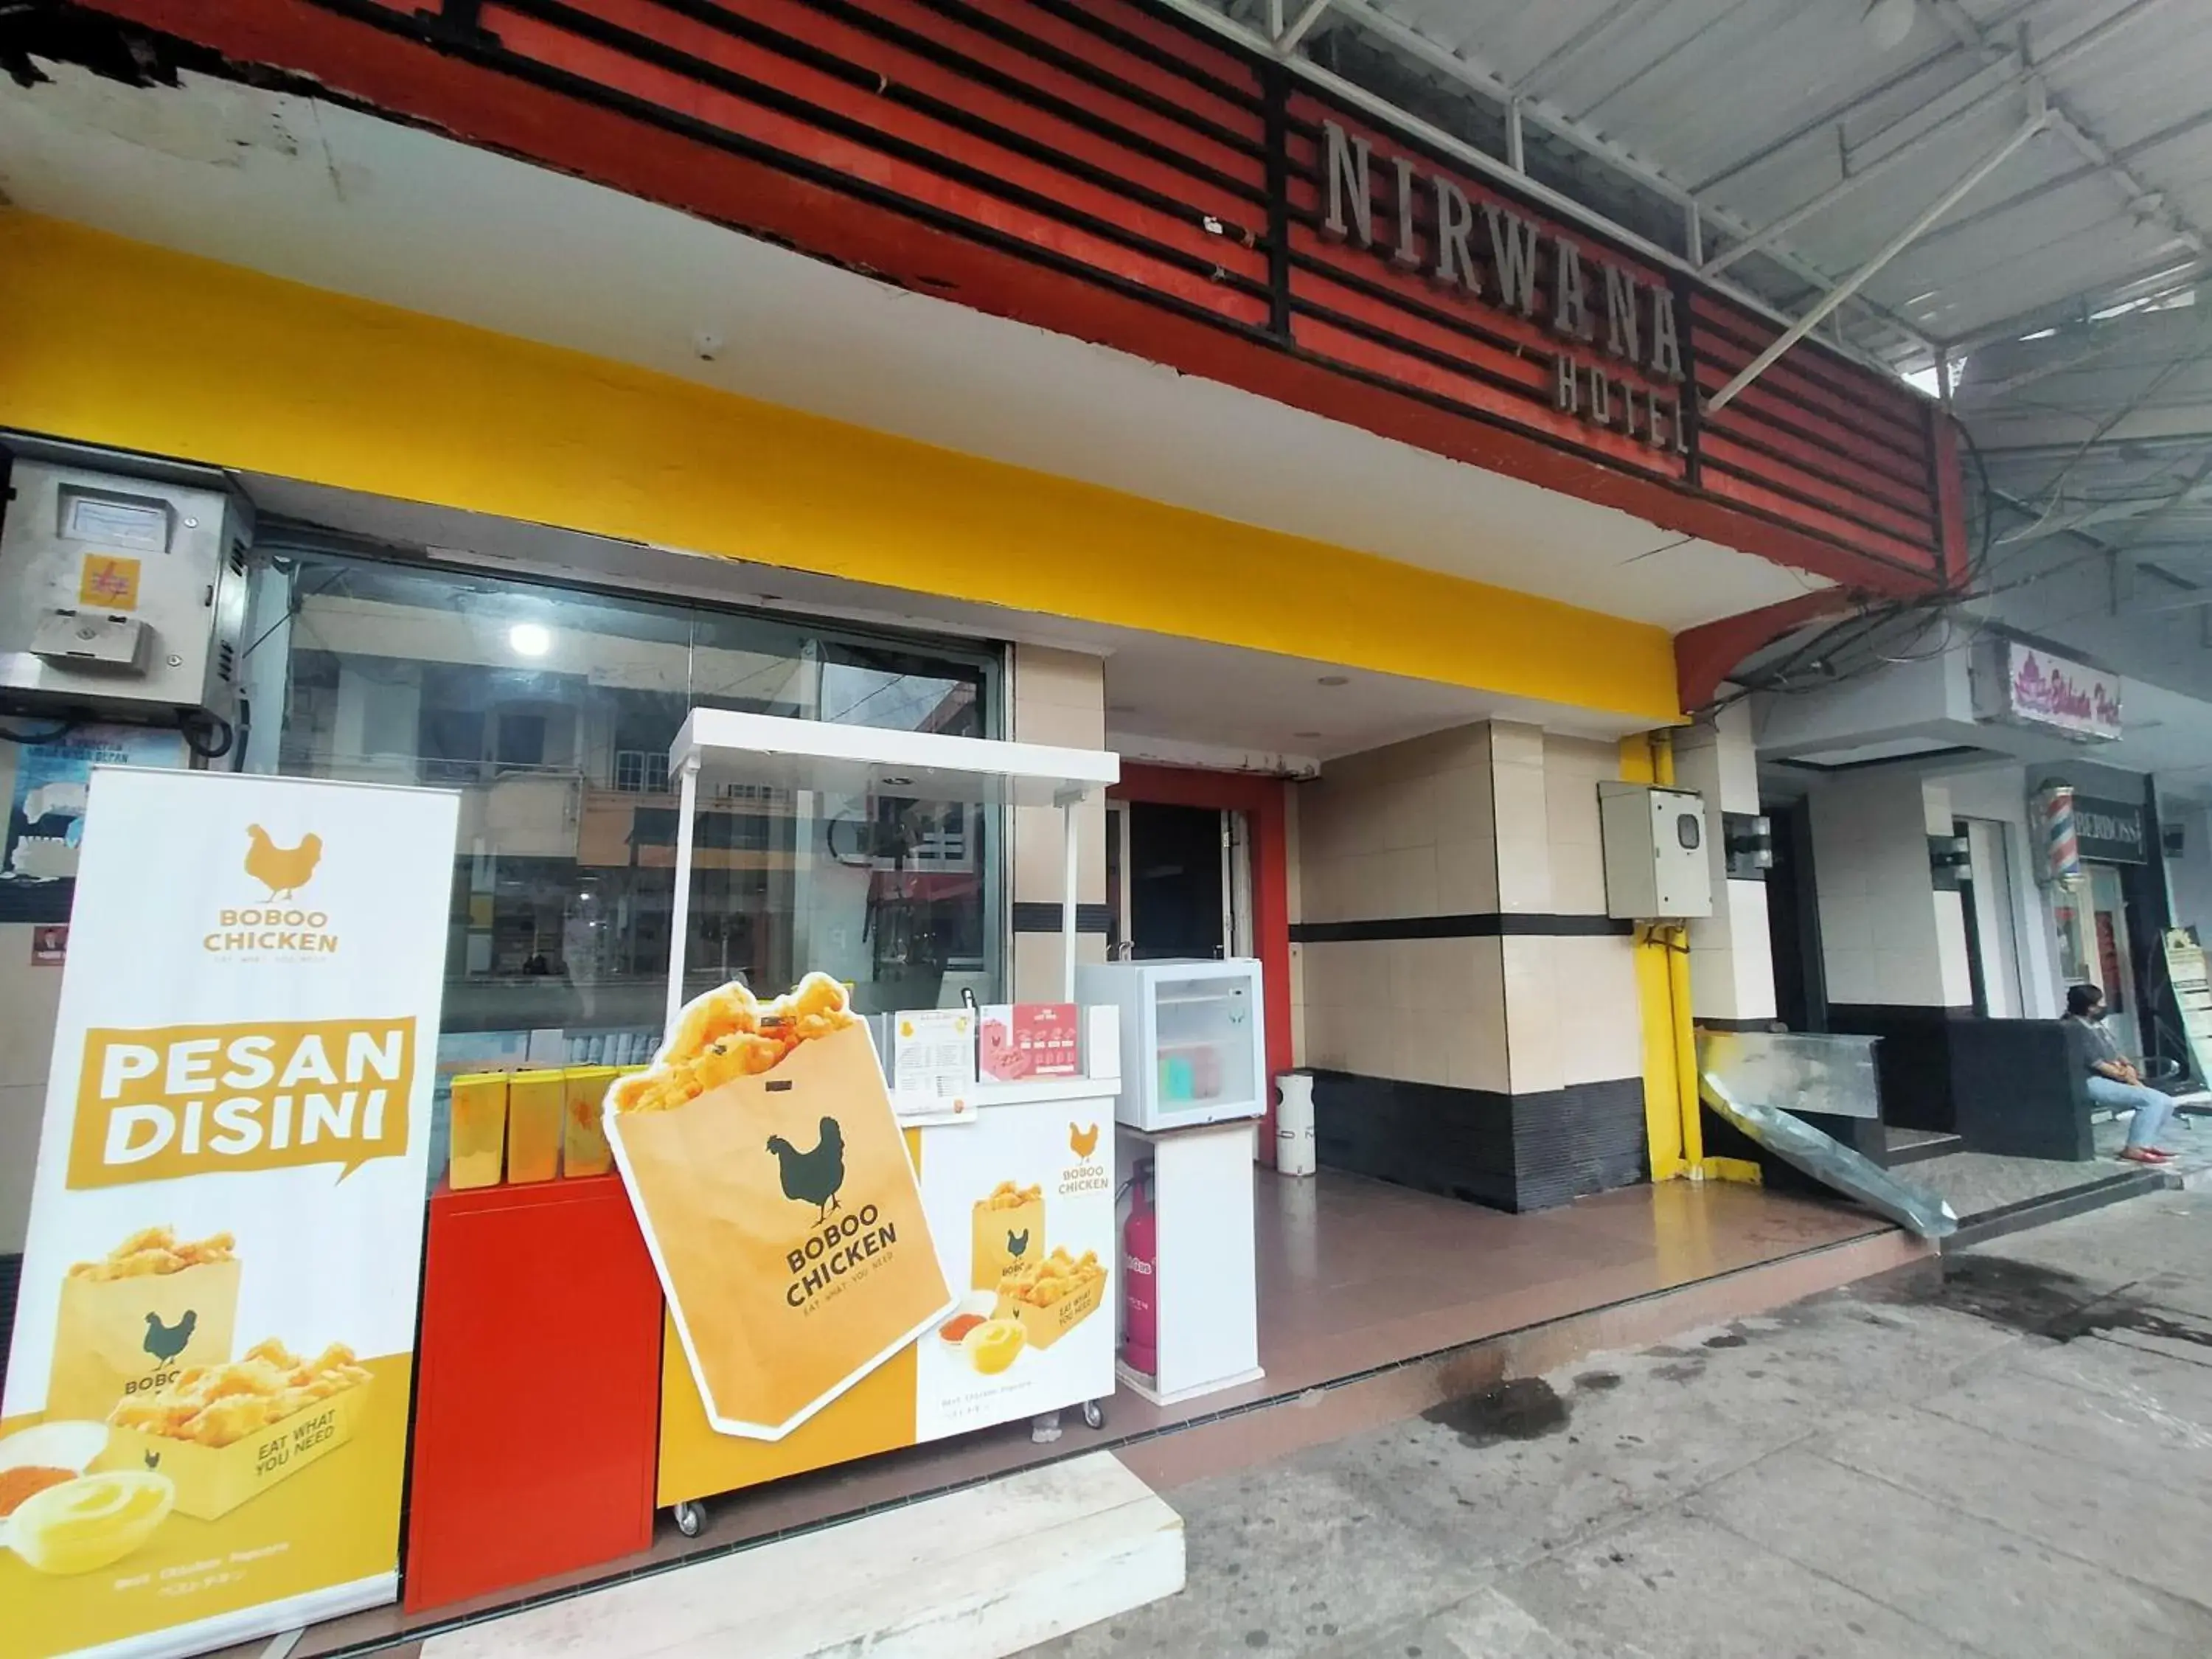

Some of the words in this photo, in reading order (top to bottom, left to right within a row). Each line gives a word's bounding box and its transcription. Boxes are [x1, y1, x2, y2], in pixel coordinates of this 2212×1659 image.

[1324, 119, 1686, 382] NIRWANA
[1559, 355, 1688, 454] HOTEL
[203, 932, 338, 953] CHICKEN
[220, 910, 328, 928] BOBOO
[100, 1030, 403, 1099] PESAN
[103, 1089, 386, 1165] DISINI
[1058, 1178, 1108, 1194] CHICKEN
[786, 1203, 878, 1275] BOBOO
[786, 1222, 897, 1307] CHICKEN
[256, 1447, 289, 1476] YOU
[293, 1425, 335, 1457] NEED
[258, 1435, 288, 1461] EAT
[293, 1408, 335, 1441] WHAT
